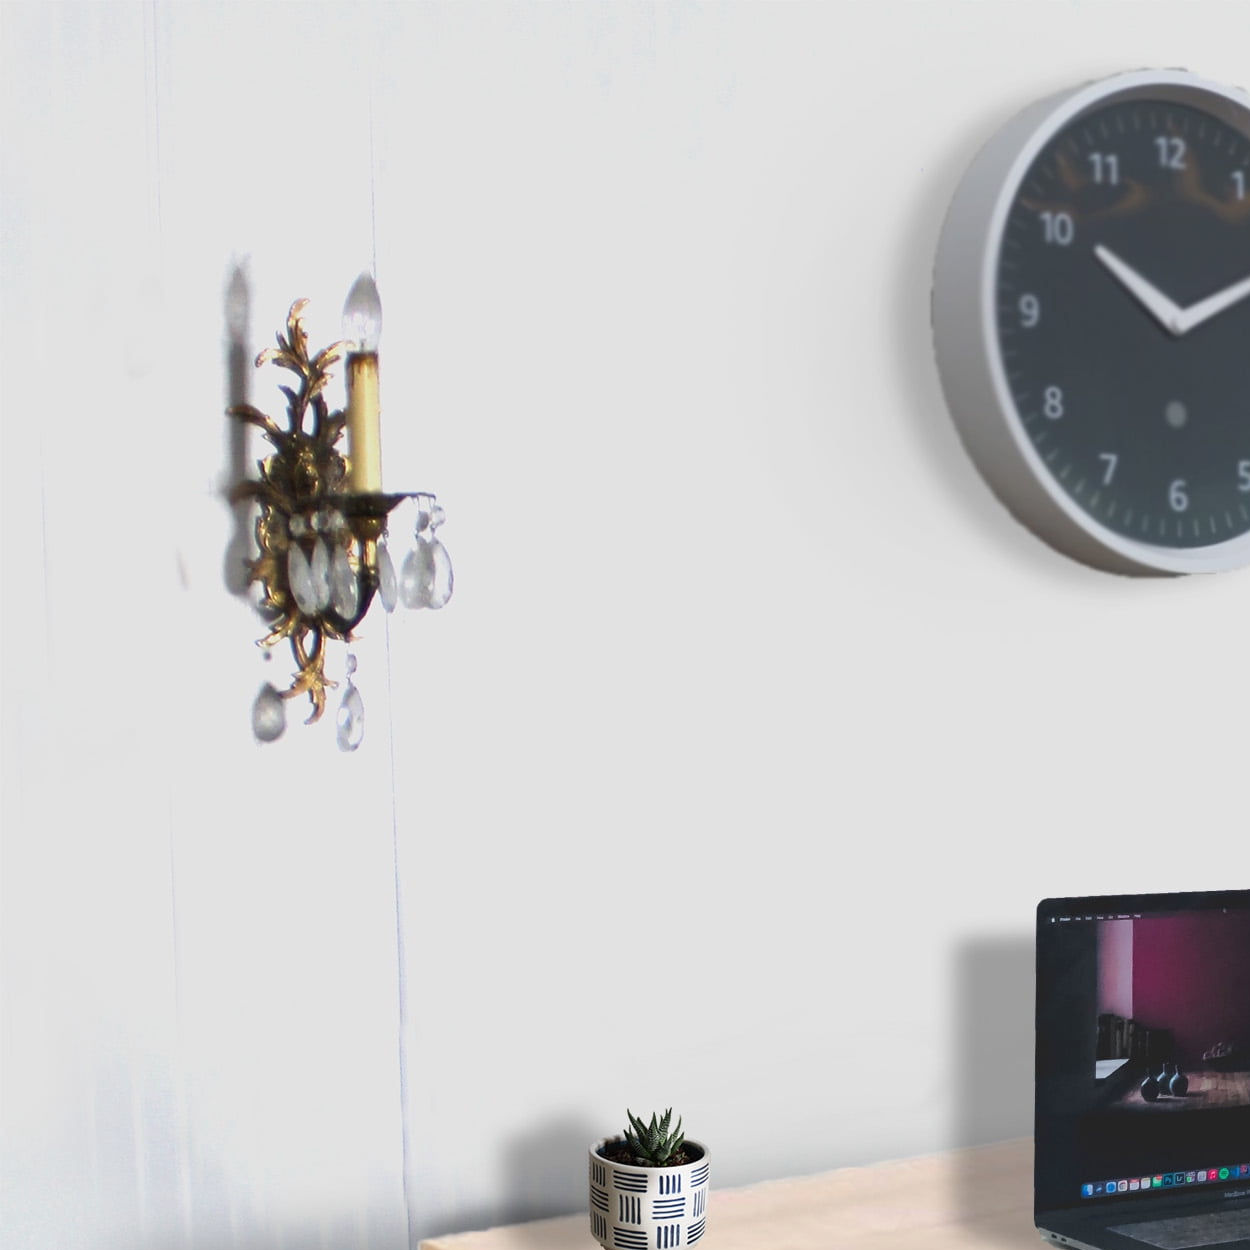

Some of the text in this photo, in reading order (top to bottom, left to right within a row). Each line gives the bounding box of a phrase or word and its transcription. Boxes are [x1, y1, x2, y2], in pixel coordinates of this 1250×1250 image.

[1089, 153, 1120, 185] 11
[1155, 137, 1187, 169] 12
[1231, 171, 1246, 199] 1
[1041, 213, 1074, 245] 10
[1019, 294, 1040, 328] 9
[1043, 386, 1064, 418] 8
[1100, 453, 1118, 486] 7
[1169, 480, 1189, 511] 6
